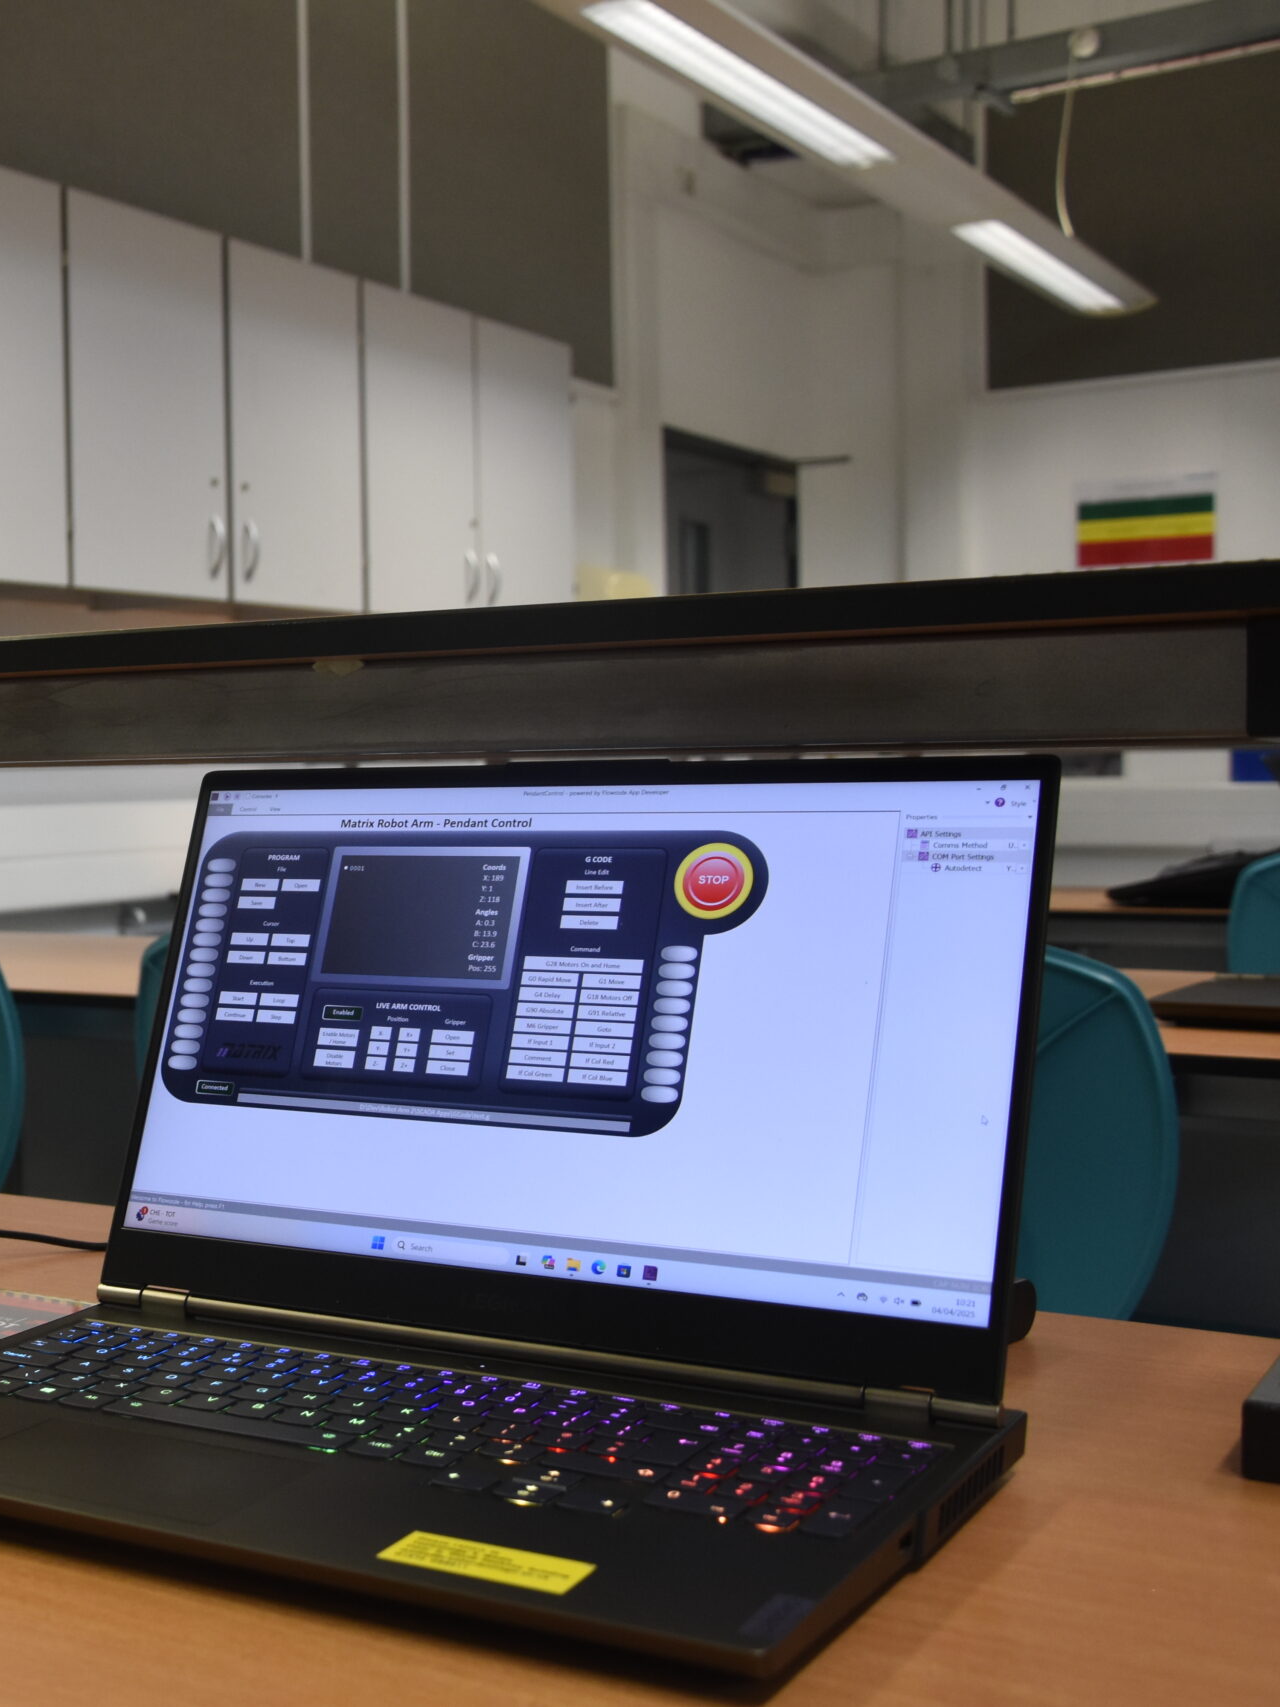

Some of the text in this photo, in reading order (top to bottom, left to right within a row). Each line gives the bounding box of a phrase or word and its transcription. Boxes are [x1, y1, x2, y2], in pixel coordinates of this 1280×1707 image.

[569, 790, 593, 798] powered
[629, 789, 640, 797] App
[640, 788, 669, 797] Developer
[1010, 800, 1027, 808] Style
[906, 813, 938, 822] Properties
[340, 818, 374, 829] Matrix
[377, 818, 408, 829] Robot
[411, 818, 434, 829] Arm
[443, 817, 488, 829] Pendant
[491, 817, 533, 828] Control
[920, 830, 962, 839] API Settings
[961, 841, 988, 849] Method
[267, 854, 301, 862] PROGRAM
[584, 855, 613, 864] G CODE
[932, 853, 995, 862] COM Port Settings
[482, 863, 507, 871] Coords
[944, 864, 982, 872] Autodetect
[597, 868, 610, 876] Edit
[482, 874, 505, 882] X: 189
[698, 875, 730, 885] STOP
[294, 882, 308, 890] Open
[479, 895, 501, 903] Z: 118
[475, 908, 499, 917] Angles
[475, 919, 495, 927] A: 0.3
[482, 930, 498, 938] 13.9
[569, 945, 601, 953] Command
[467, 953, 495, 962] Gripper
[468, 964, 483, 972] Pos:
[559, 961, 579, 969] Motors
[249, 979, 274, 987] Execution
[537, 975, 555, 984] Rapid
[543, 991, 561, 1000] Delay
[375, 1002, 441, 1012] LIVE ARM CONTROL
[539, 1007, 564, 1015] Absolute
[332, 1009, 355, 1017] Enabled
[602, 1010, 626, 1018] Relative
[386, 1015, 409, 1023] Position
[444, 1018, 466, 1026] Gripper
[537, 1023, 559, 1031] Gripper
[444, 1033, 461, 1042] Open
[532, 1038, 549, 1046] Input
[594, 1042, 610, 1050] Input
[523, 1054, 552, 1062] Comment
[590, 1058, 601, 1066] Col
[439, 1064, 456, 1072] Close
[201, 1083, 229, 1092] Connected
[148, 1218, 163, 1226] Game
[410, 1242, 433, 1253] Search
